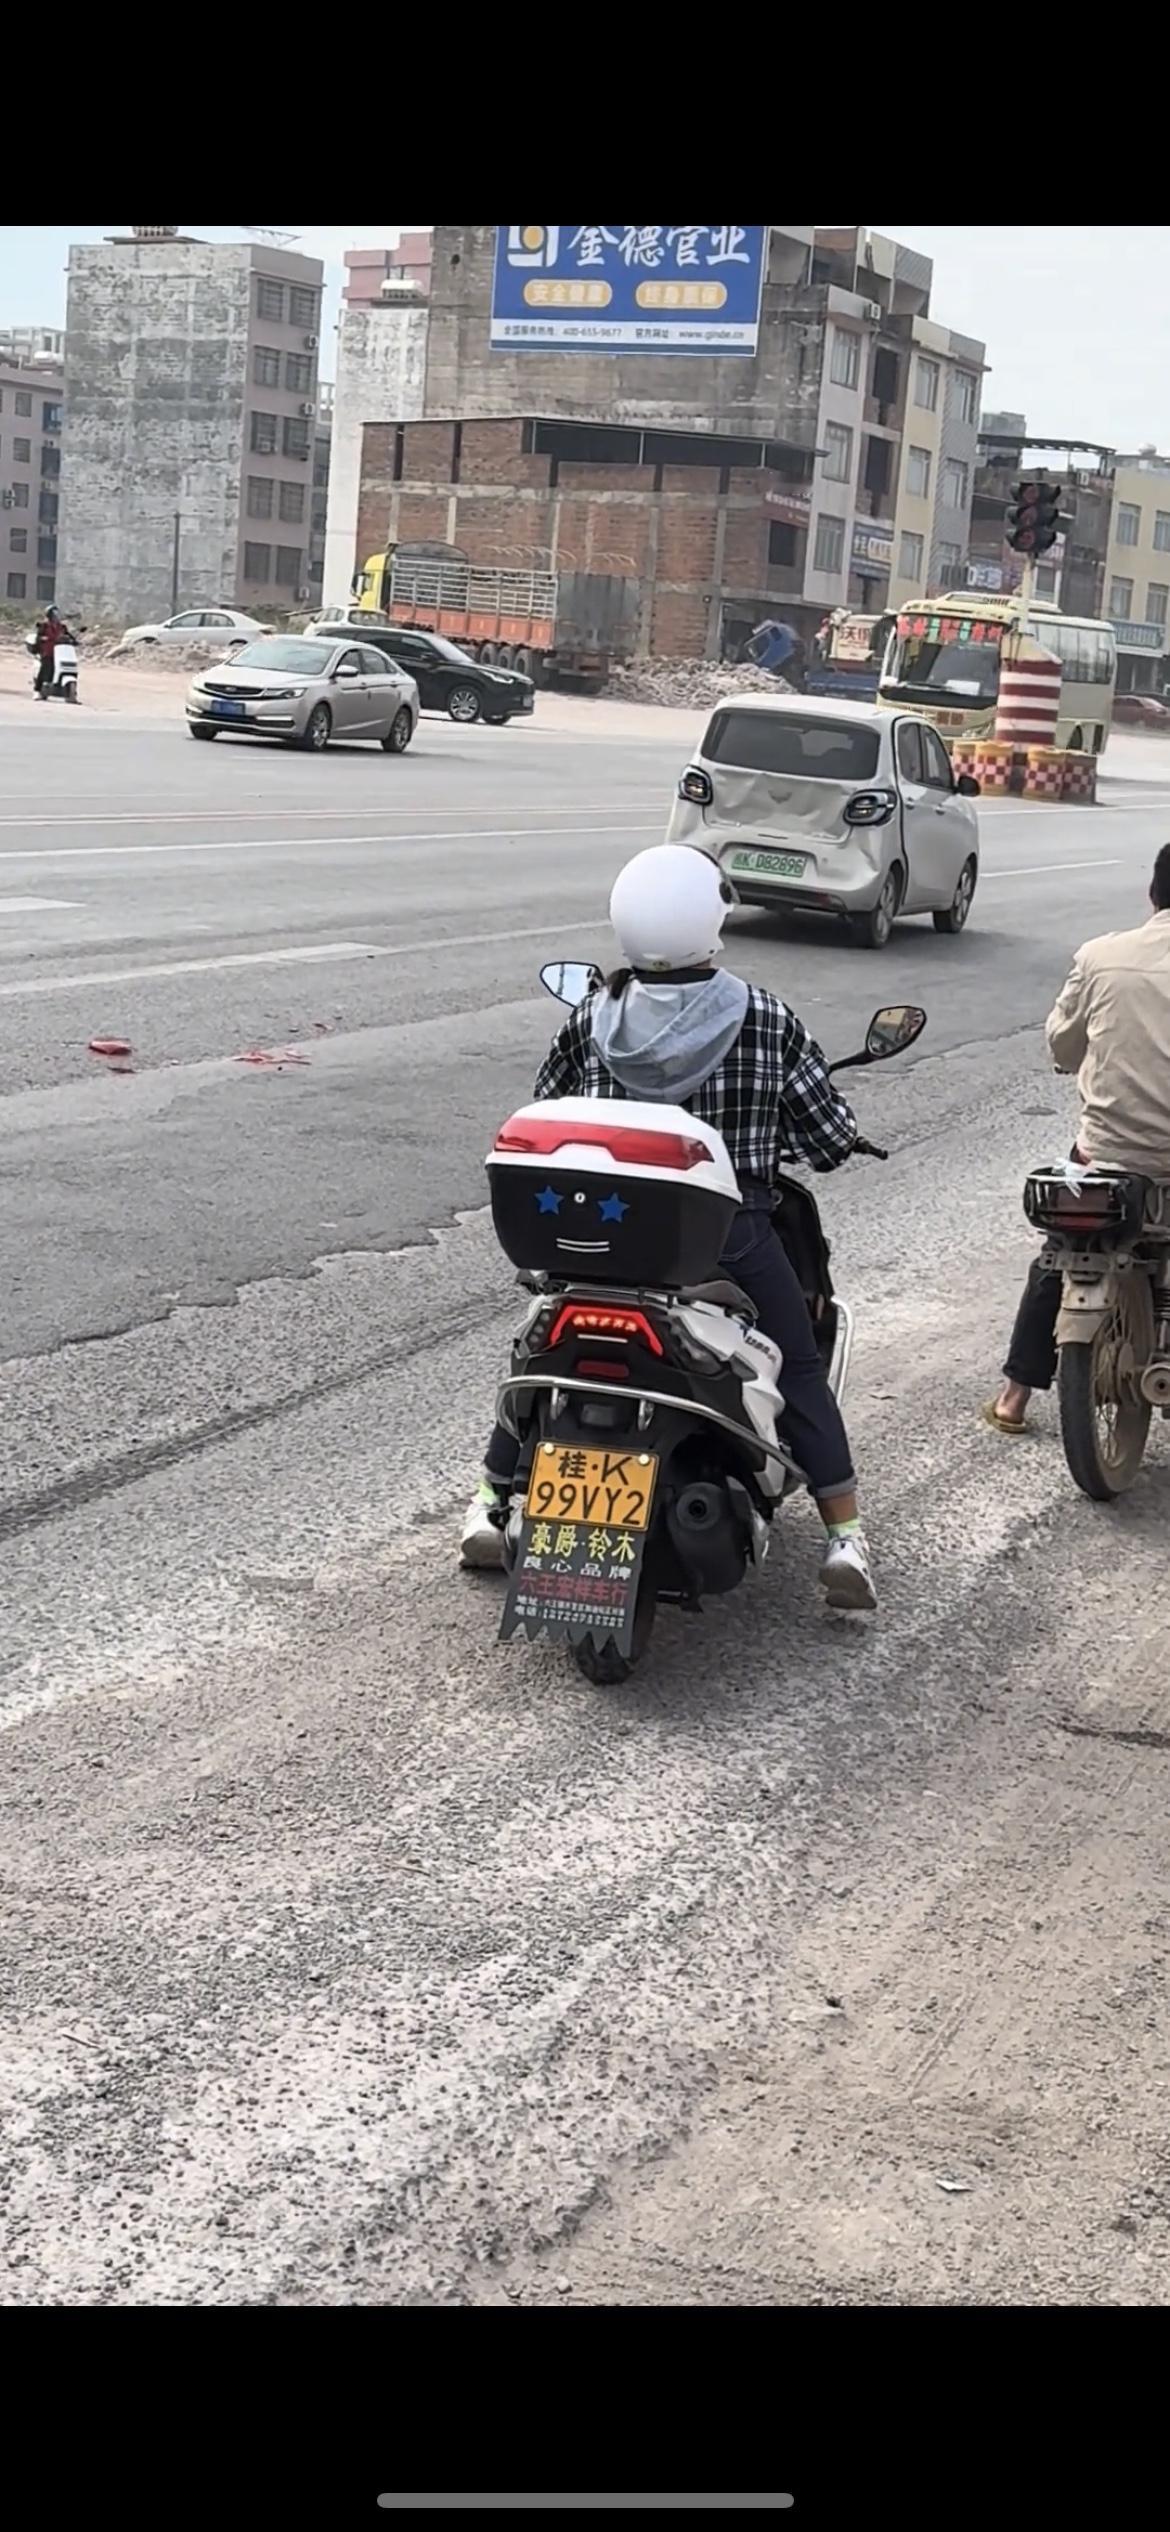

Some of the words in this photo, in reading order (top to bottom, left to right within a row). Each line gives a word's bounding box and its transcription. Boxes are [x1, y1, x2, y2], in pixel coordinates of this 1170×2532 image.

[567, 226, 750, 267] 金德管业
[557, 1450, 633, 1486] 桂·K
[536, 1480, 645, 1526] 99VY2
